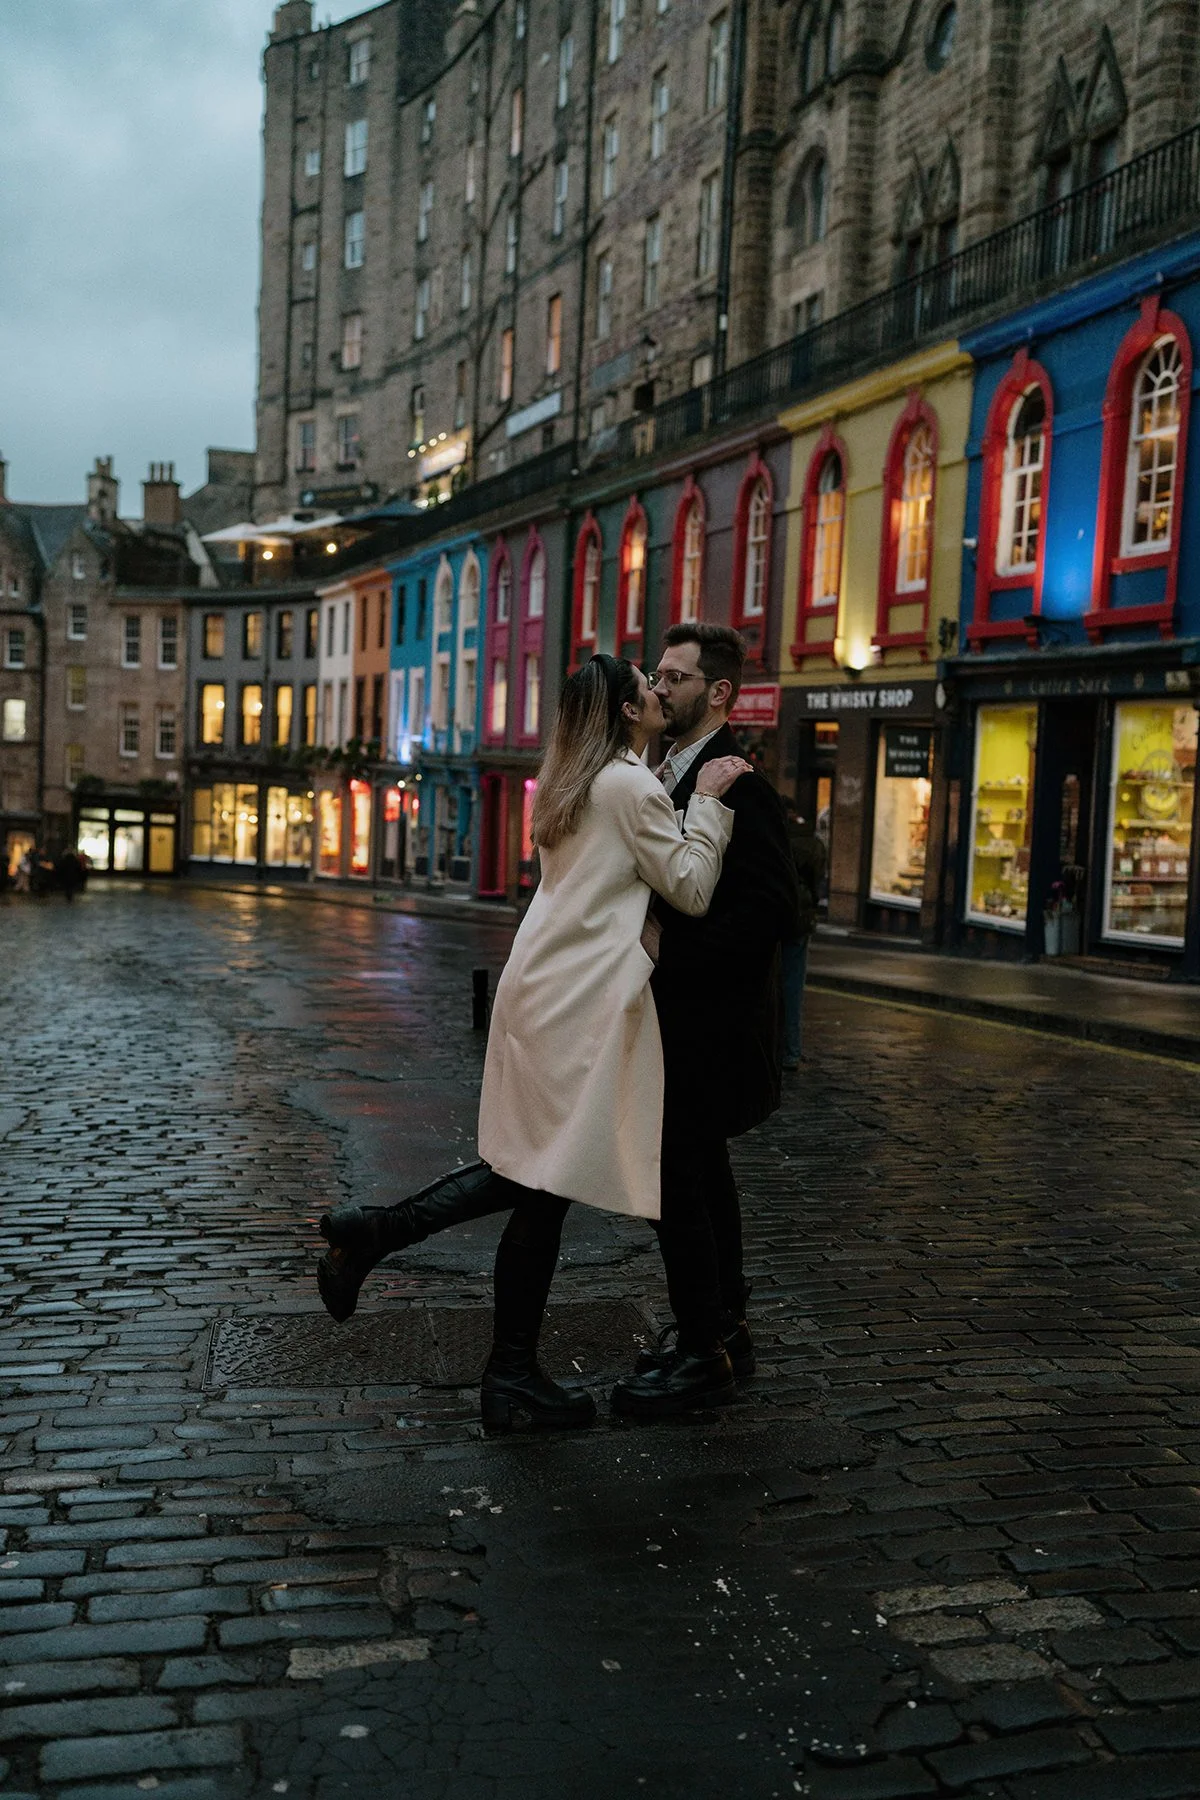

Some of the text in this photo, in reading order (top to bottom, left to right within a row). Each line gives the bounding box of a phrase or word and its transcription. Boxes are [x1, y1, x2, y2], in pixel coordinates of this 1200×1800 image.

[806, 688, 913, 709] THE WHISKY SHOP
[900, 735, 918, 745] THE
[889, 750, 928, 759] WHISKY
[894, 764, 921, 773] SHOP
